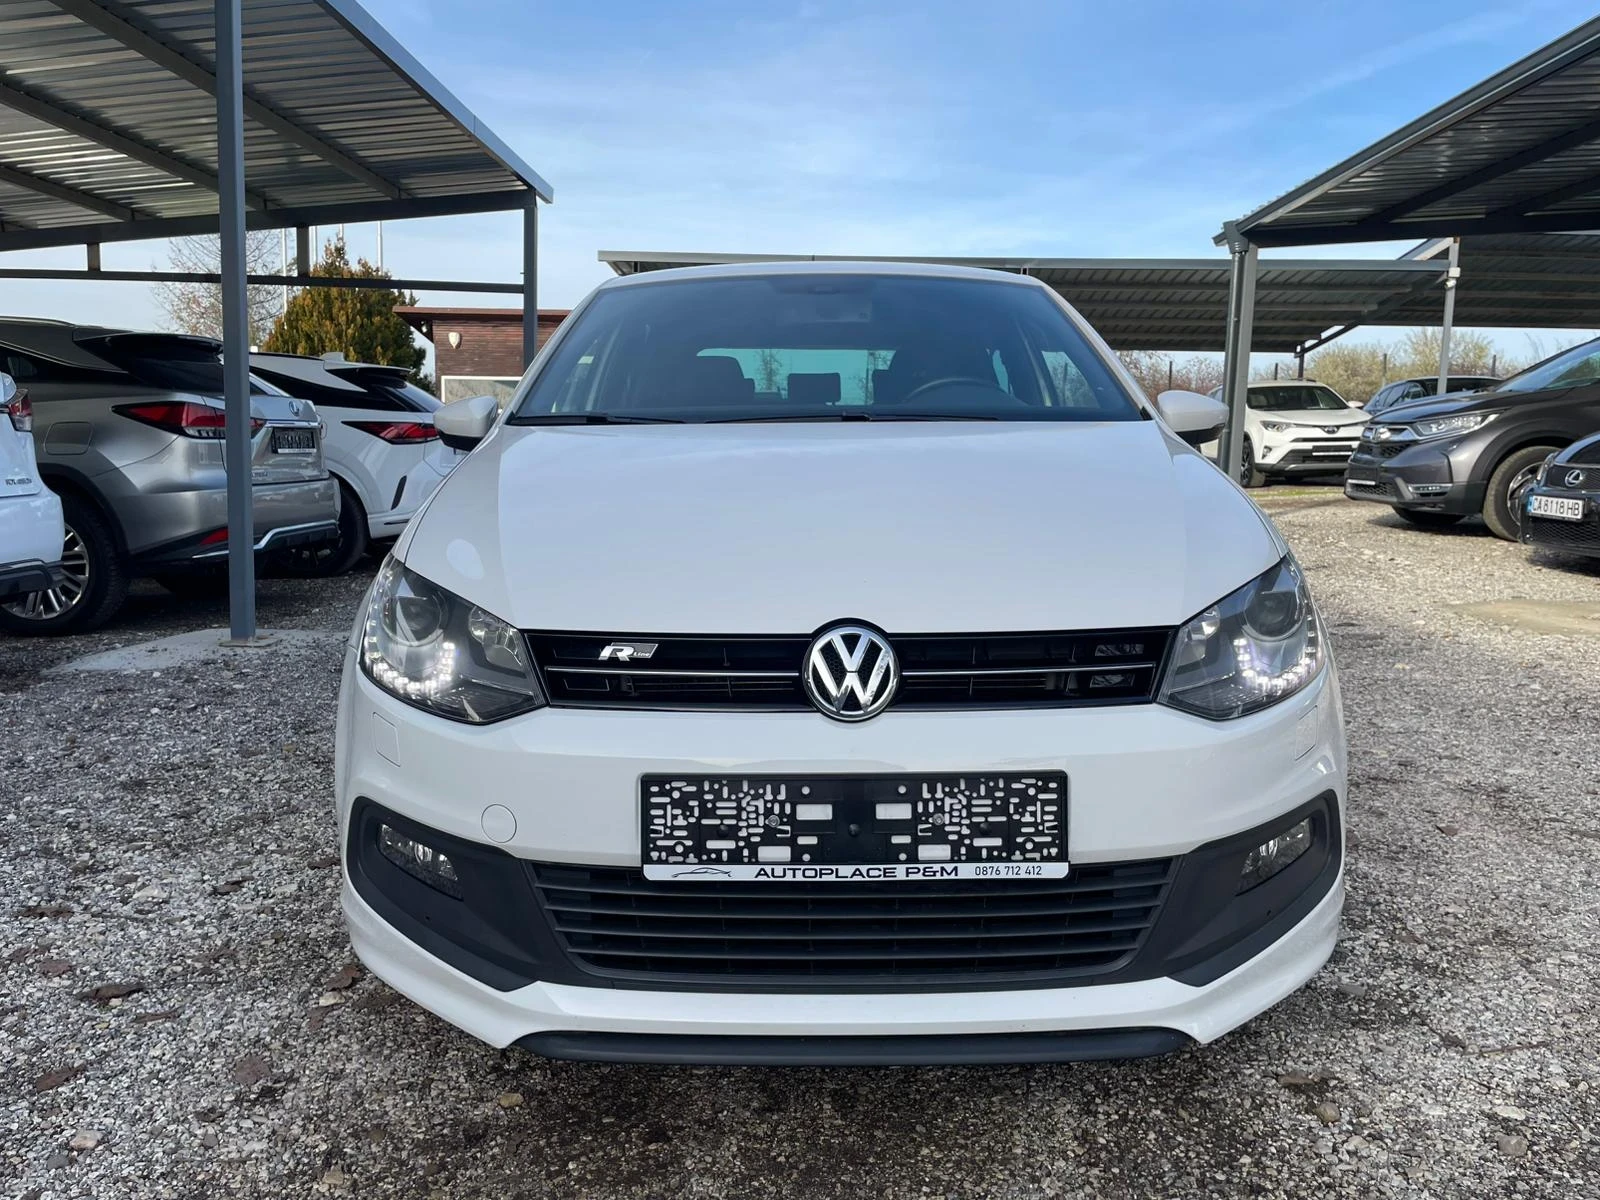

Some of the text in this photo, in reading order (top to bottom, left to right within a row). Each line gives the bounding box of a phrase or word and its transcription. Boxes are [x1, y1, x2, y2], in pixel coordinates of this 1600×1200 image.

[754, 866, 1042, 879] AUTOPLACE P&M 0876 712 412
